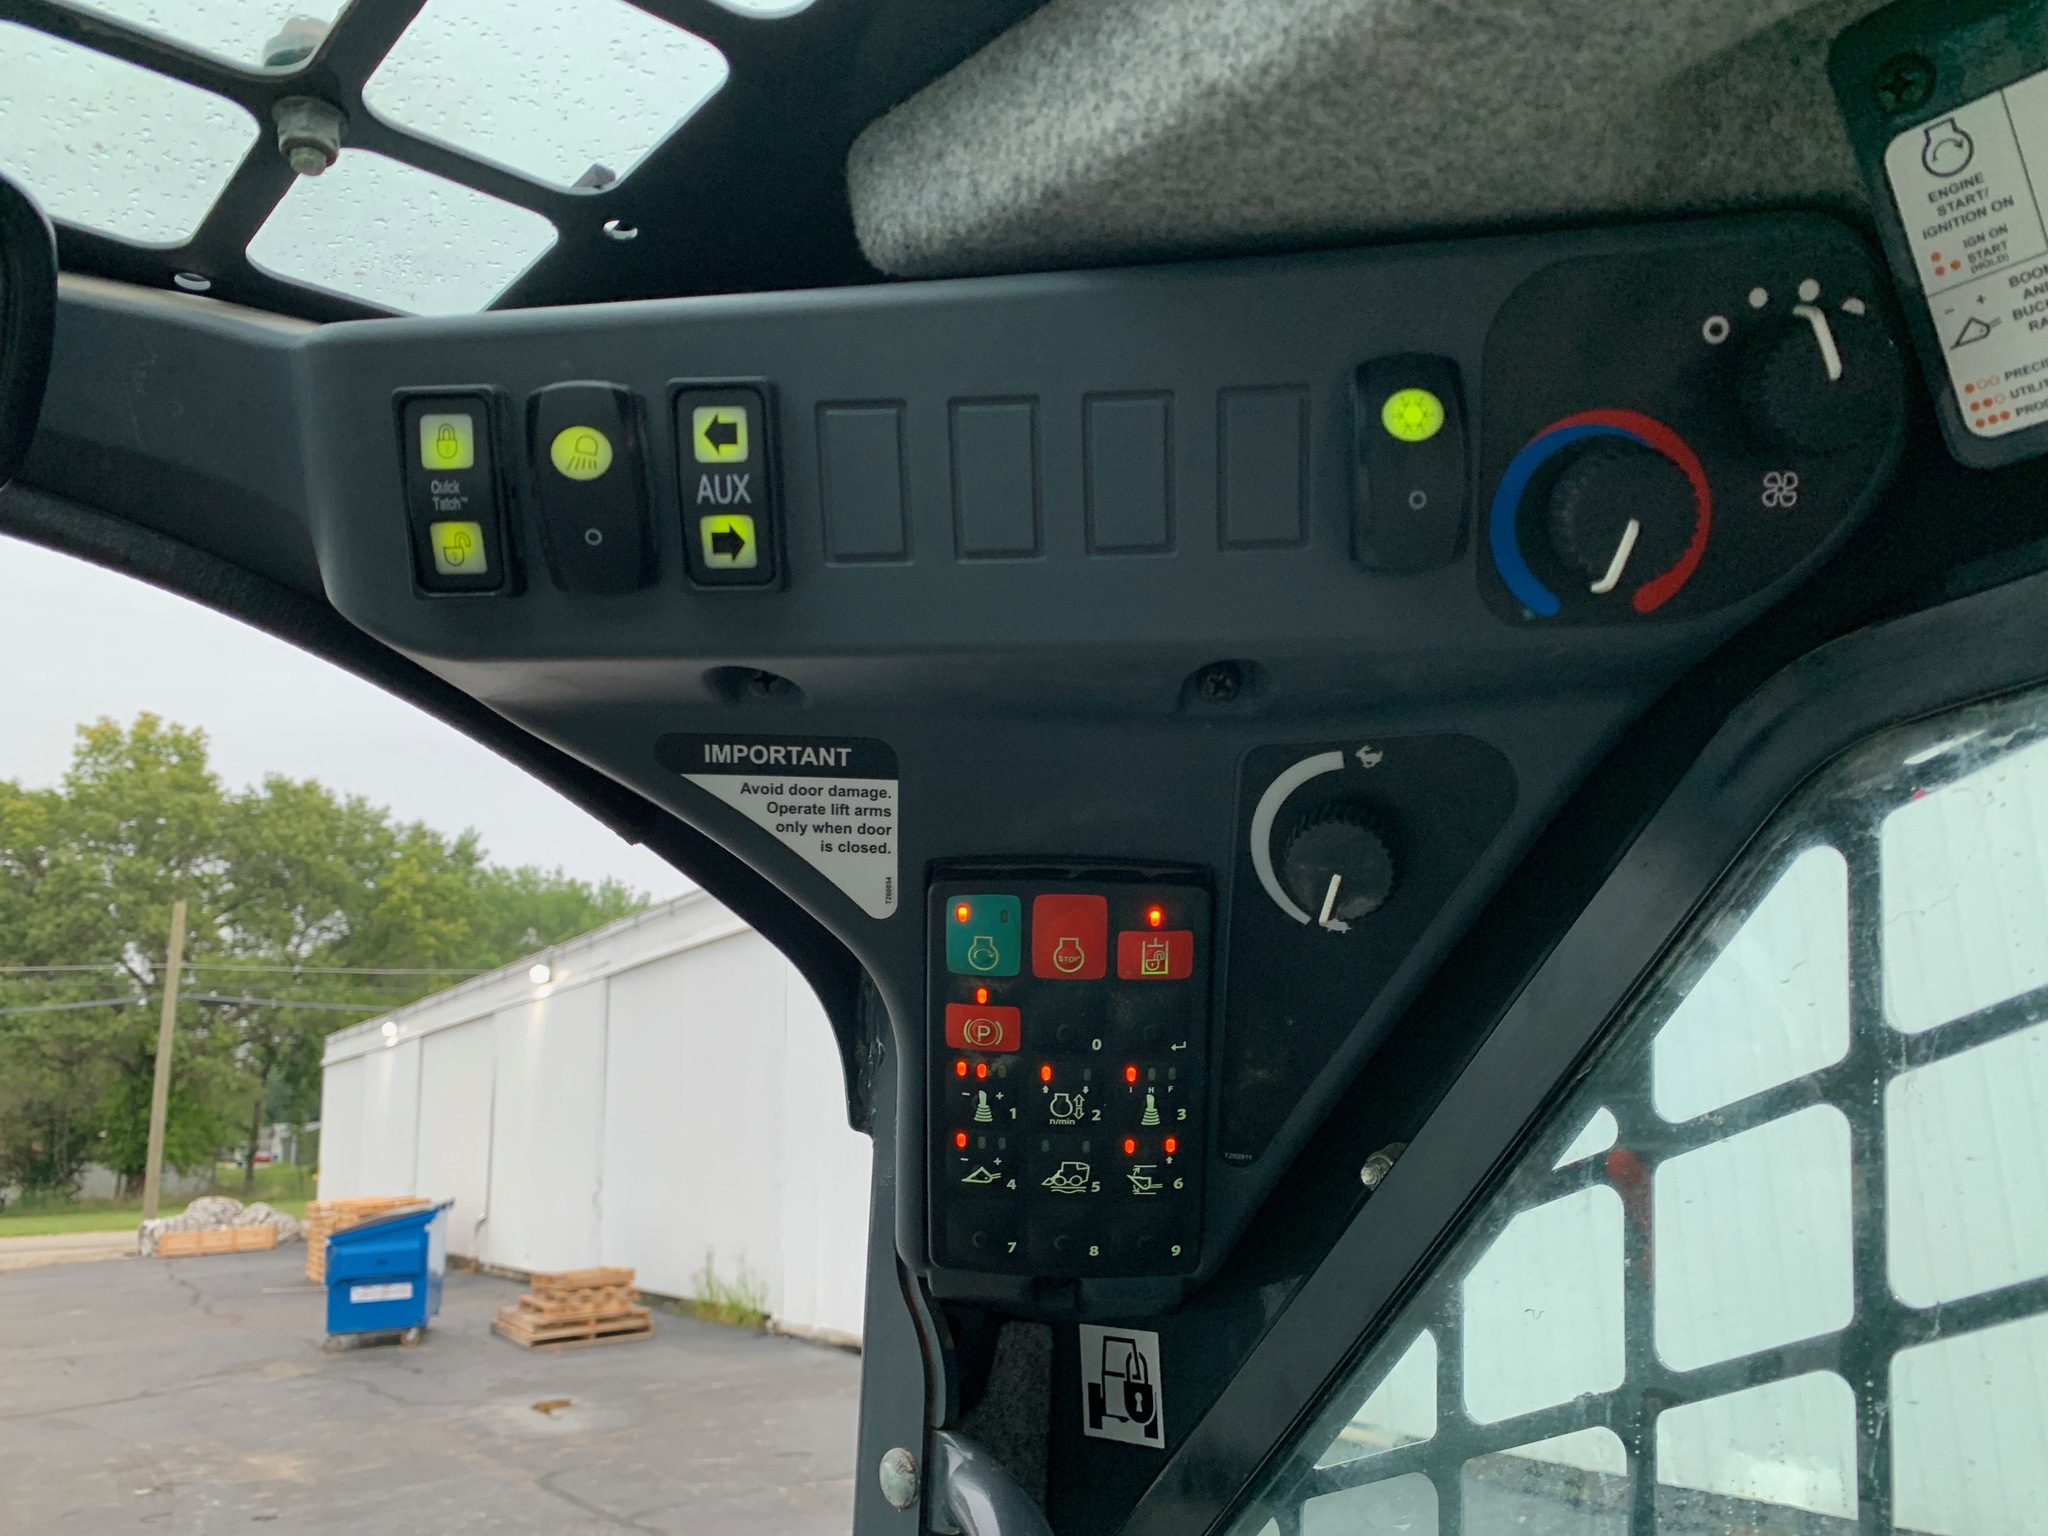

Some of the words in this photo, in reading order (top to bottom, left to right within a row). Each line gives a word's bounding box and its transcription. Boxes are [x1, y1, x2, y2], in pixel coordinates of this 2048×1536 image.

[1928, 171, 1985, 204] ENGINE
[1936, 186, 1989, 216] START/
[1922, 206, 1988, 240] IGNITION
[1991, 194, 2015, 212] ON
[1962, 232, 1986, 249] IGN
[1988, 223, 2008, 239] ON
[1967, 240, 2008, 264] START
[1970, 253, 2010, 275] (HOLD)
[2012, 299, 2048, 321] BUC
[696, 473, 752, 505] AUX
[703, 743, 852, 767] IMPORTANT
[740, 782, 784, 796] Avoid
[788, 783, 824, 797] door
[828, 784, 892, 801] damage.
[766, 801, 826, 817] Operate
[830, 803, 850, 816] lift
[854, 806, 892, 817] arms
[775, 821, 808, 837] only
[812, 822, 852, 835] when
[857, 822, 892, 836] door
[820, 840, 833, 853] is
[838, 840, 892, 855] closed.
[1057, 955, 1081, 963] STOP
[977, 1025, 991, 1042] P
[1148, 1086, 1155, 1094] H
[1167, 1085, 1174, 1093] F
[1009, 1107, 1017, 1120] 1
[1091, 1109, 1101, 1121] 2
[1176, 1108, 1187, 1120] 3
[1049, 1117, 1076, 1126] n/min
[1006, 1179, 1017, 1190] 4
[1091, 1181, 1101, 1192] 5
[1173, 1178, 1184, 1189] 6
[1007, 1242, 1017, 1253] 7
[1089, 1245, 1099, 1257] 8
[1171, 1245, 1181, 1257] 9
